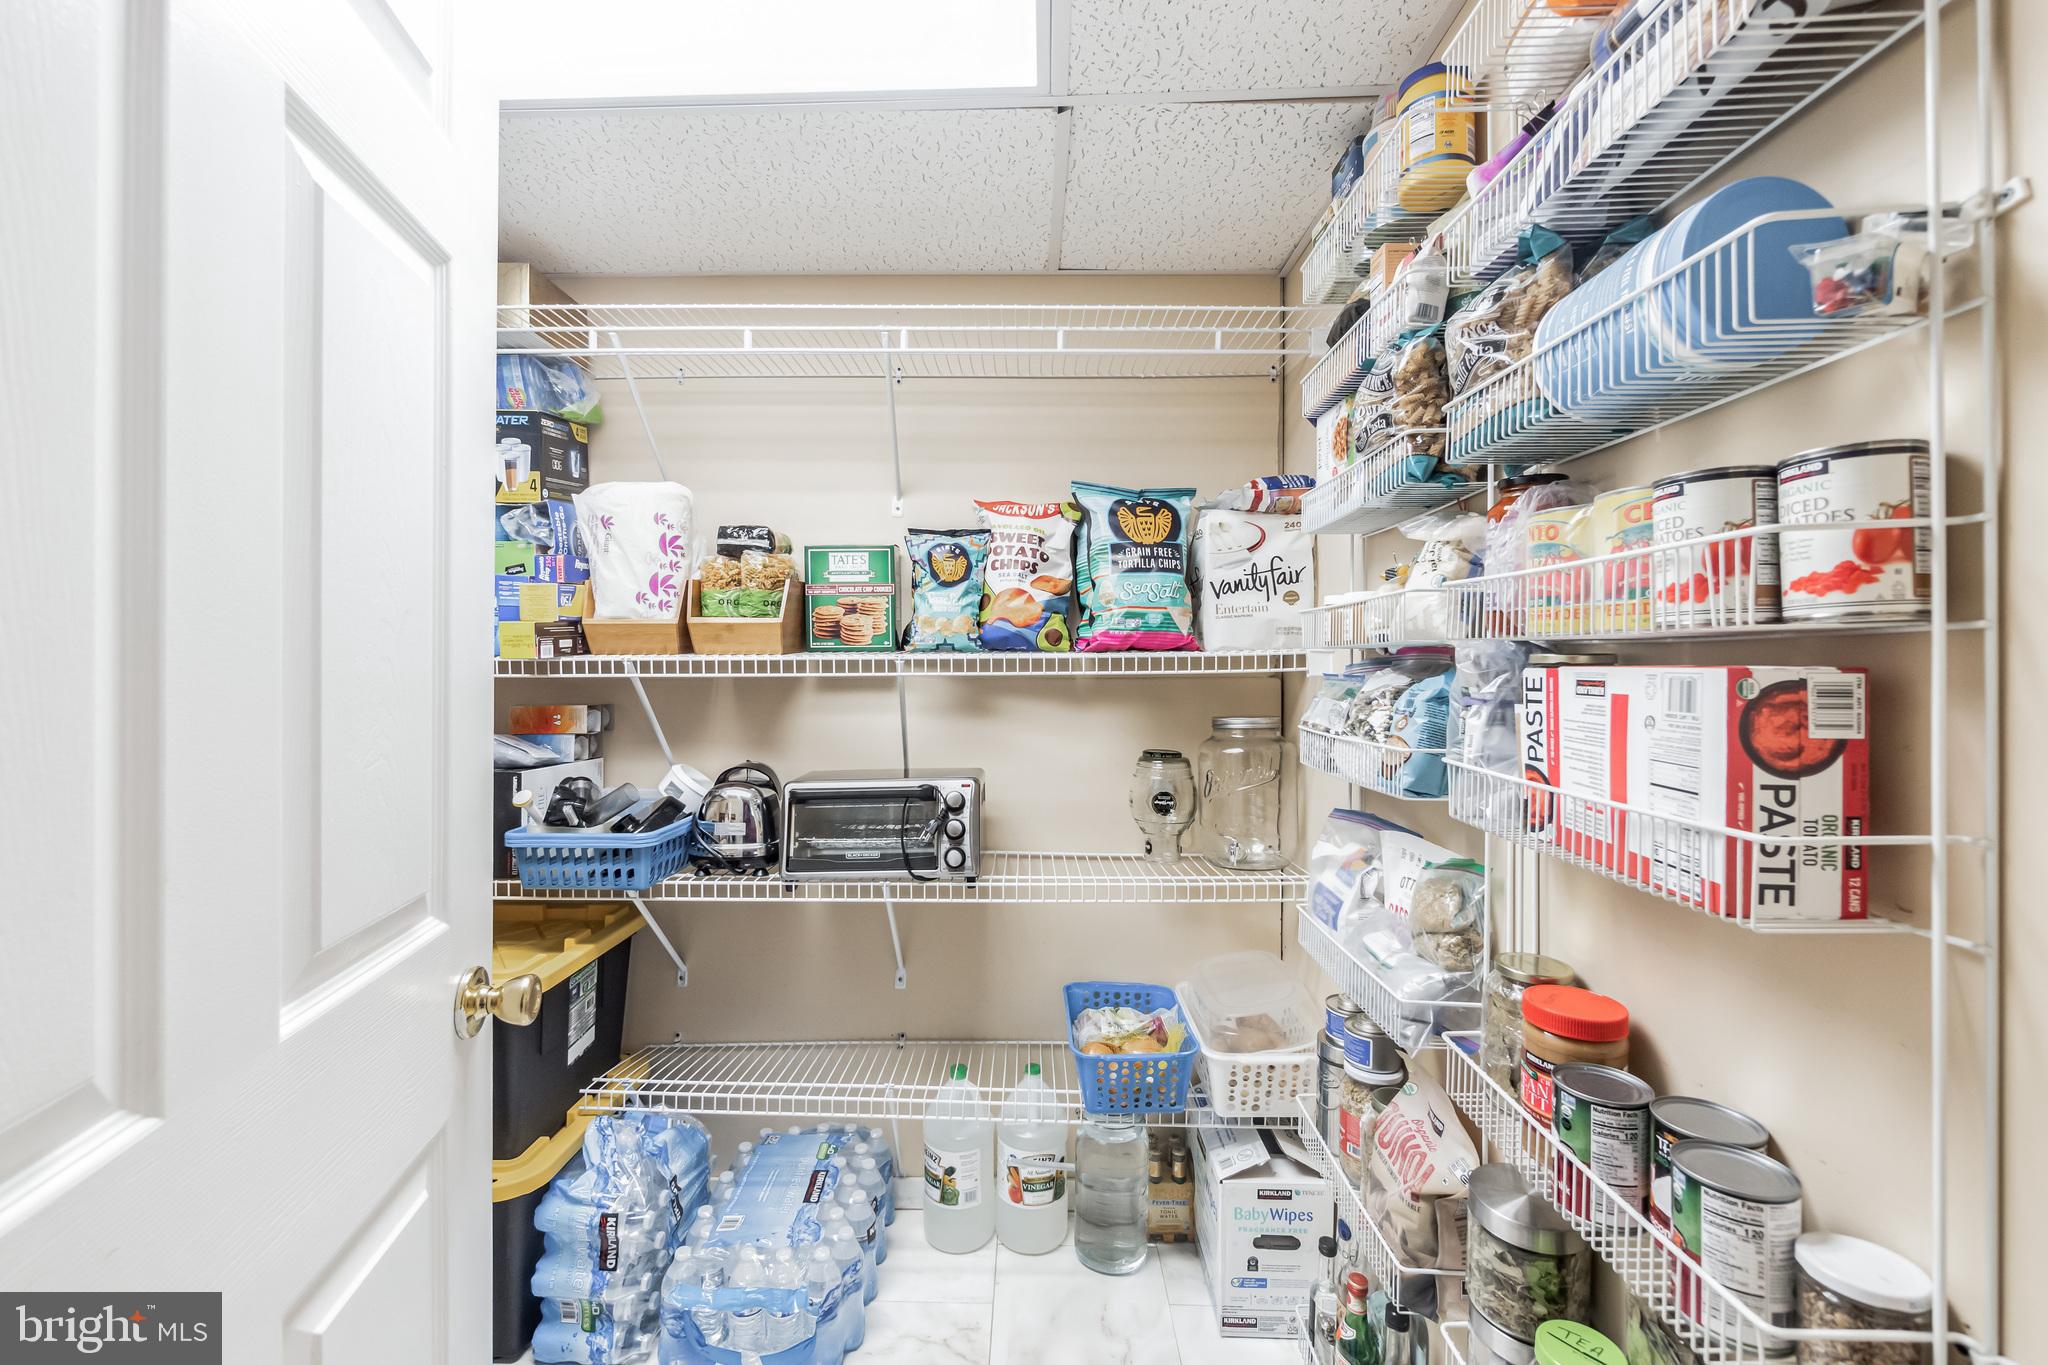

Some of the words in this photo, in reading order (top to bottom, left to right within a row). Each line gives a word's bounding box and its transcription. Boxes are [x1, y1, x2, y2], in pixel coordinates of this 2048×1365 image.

[496, 415, 529, 426] ATER
[529, 479, 537, 492] 4
[992, 503, 1056, 517] JACKSON'S
[1284, 521, 1302, 529] 240
[991, 531, 1046, 548] SWEET
[1125, 546, 1151, 558] GRAIN
[1154, 546, 1173, 558] FREE
[990, 559, 1039, 575] CHIPS
[1117, 557, 1156, 570] TORTILLA
[1158, 558, 1181, 570] CHIPS
[1119, 581, 1151, 601] Sea
[1147, 580, 1182, 602] Salt
[1215, 601, 1270, 615] Entertain
[1525, 675, 1544, 763] PASTE
[1758, 784, 1796, 907] PASTE
[1848, 877, 1862, 887] 12
[1848, 887, 1862, 912] CANS
[1592, 1106, 1622, 1118] Nutrition
[1592, 1128, 1620, 1139] Calories
[1624, 1132, 1639, 1140] 120
[1022, 1181, 1054, 1191] VINEGAR
[1741, 1201, 1764, 1213] Facts
[1233, 1206, 1270, 1225] Baby
[1269, 1207, 1314, 1226] Wipes
[1703, 1217, 1737, 1234] Calories
[1744, 1228, 1765, 1240] 120
[1223, 1317, 1257, 1325] KIRKLAND
[1557, 1325, 1605, 1358] TEA
